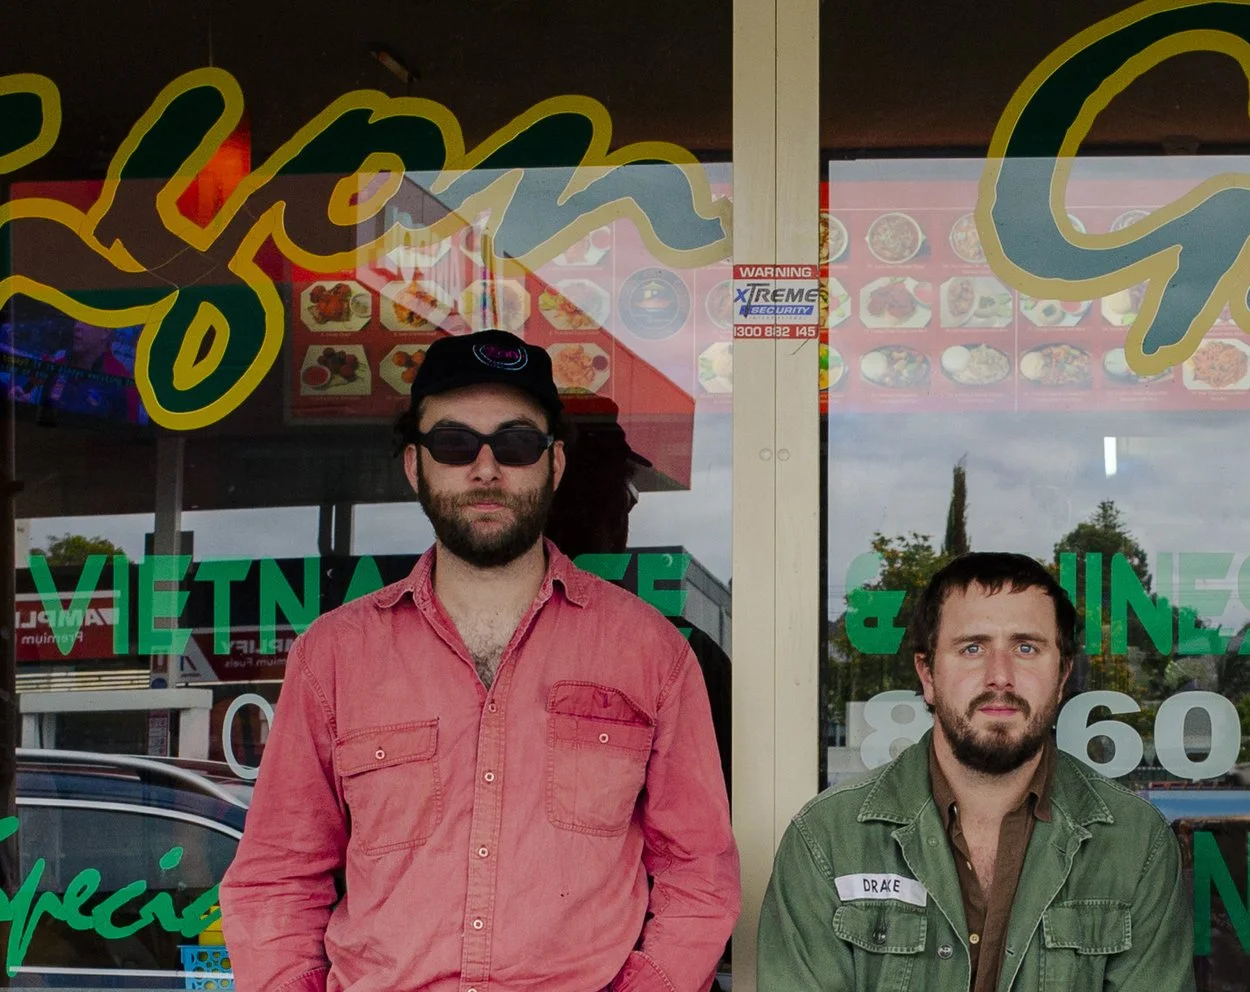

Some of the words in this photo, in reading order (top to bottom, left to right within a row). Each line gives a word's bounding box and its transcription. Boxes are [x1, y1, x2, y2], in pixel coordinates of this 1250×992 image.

[740, 267, 811, 277] WARNING
[751, 306, 809, 314] SECURITY
[796, 326, 816, 337] 145
[863, 878, 901, 893] DRAKE
